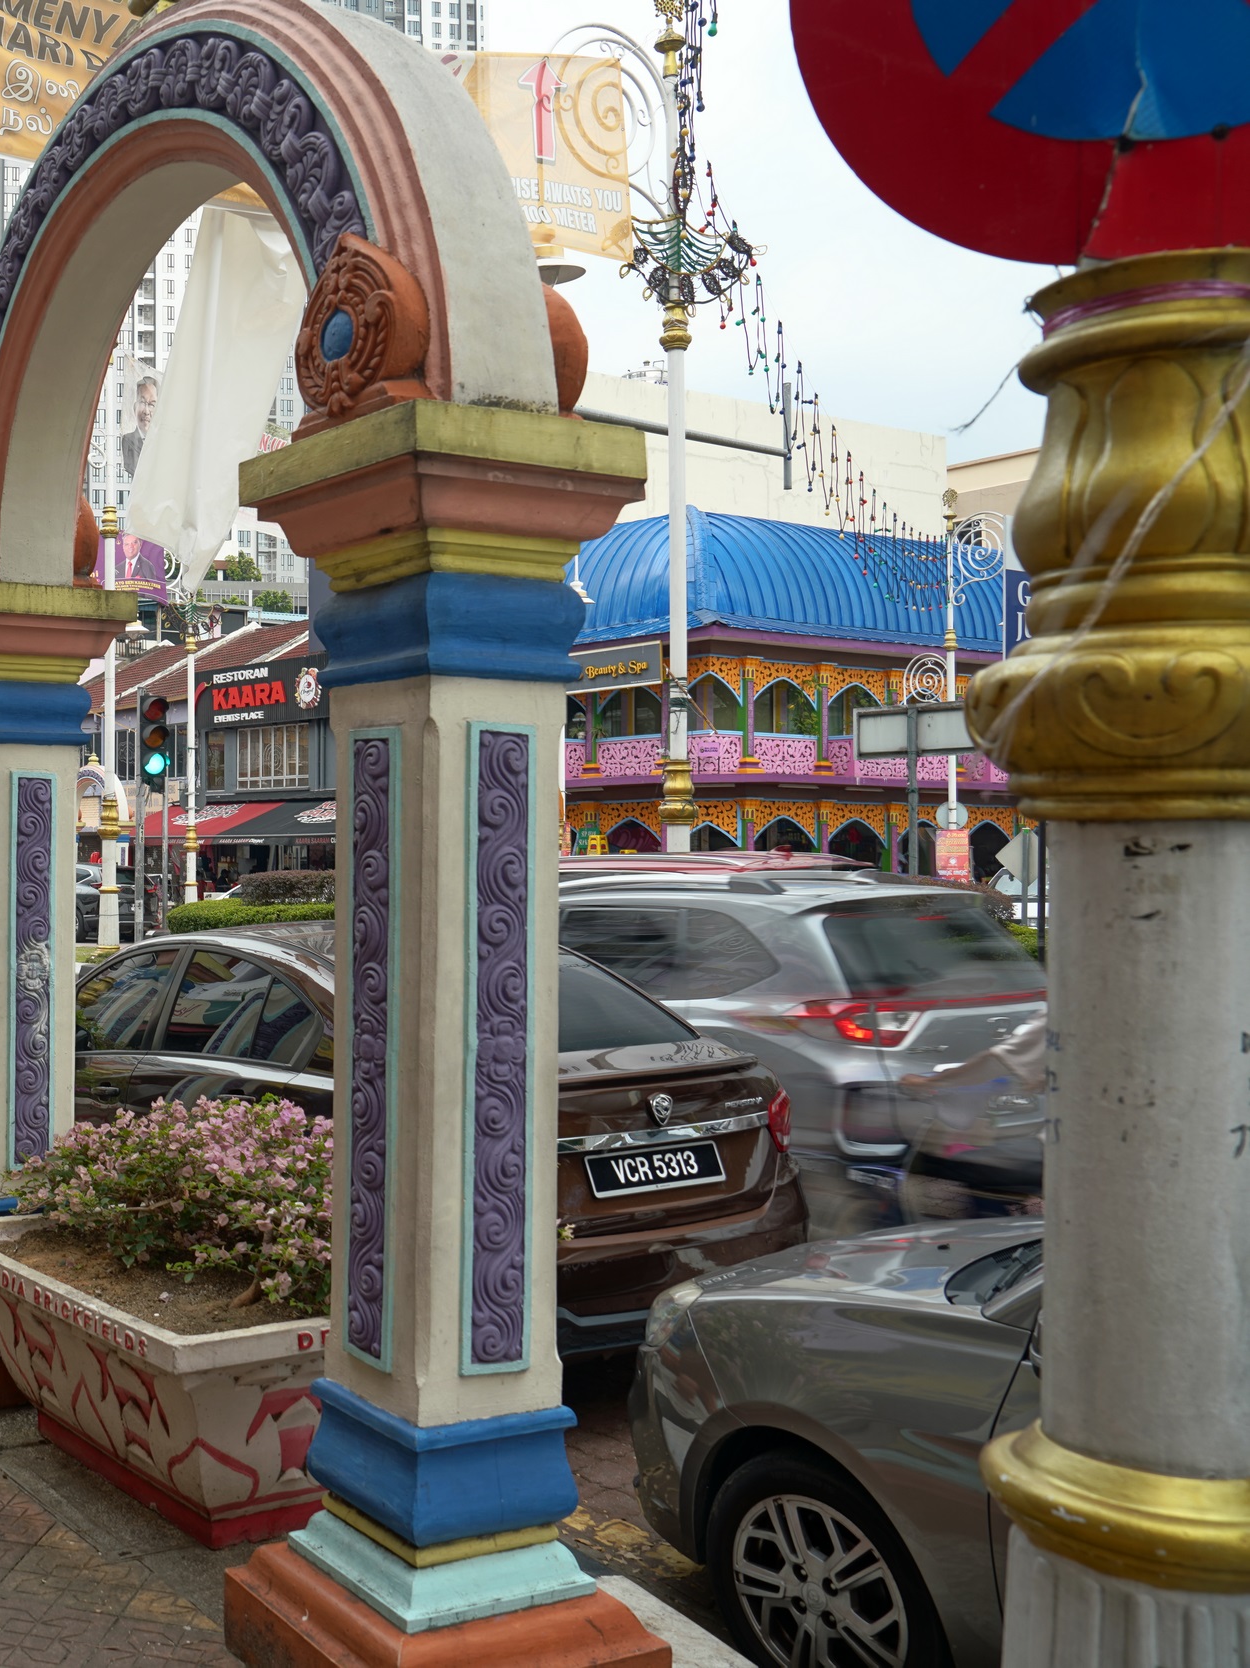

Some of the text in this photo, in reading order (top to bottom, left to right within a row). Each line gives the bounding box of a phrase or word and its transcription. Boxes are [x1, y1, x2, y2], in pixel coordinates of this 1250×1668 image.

[544, 180, 592, 208] AWAITS
[594, 187, 623, 213] YOU
[522, 205, 598, 234] 100 METER
[213, 667, 269, 685] RESTORAN
[584, 660, 648, 679] Beauty & Spa
[212, 680, 287, 711] KAARA
[213, 710, 265, 724] EVENTS PLACE
[610, 1150, 700, 1185] VCR 5313
[33, 1285, 150, 1357] BRICKFIELDS
